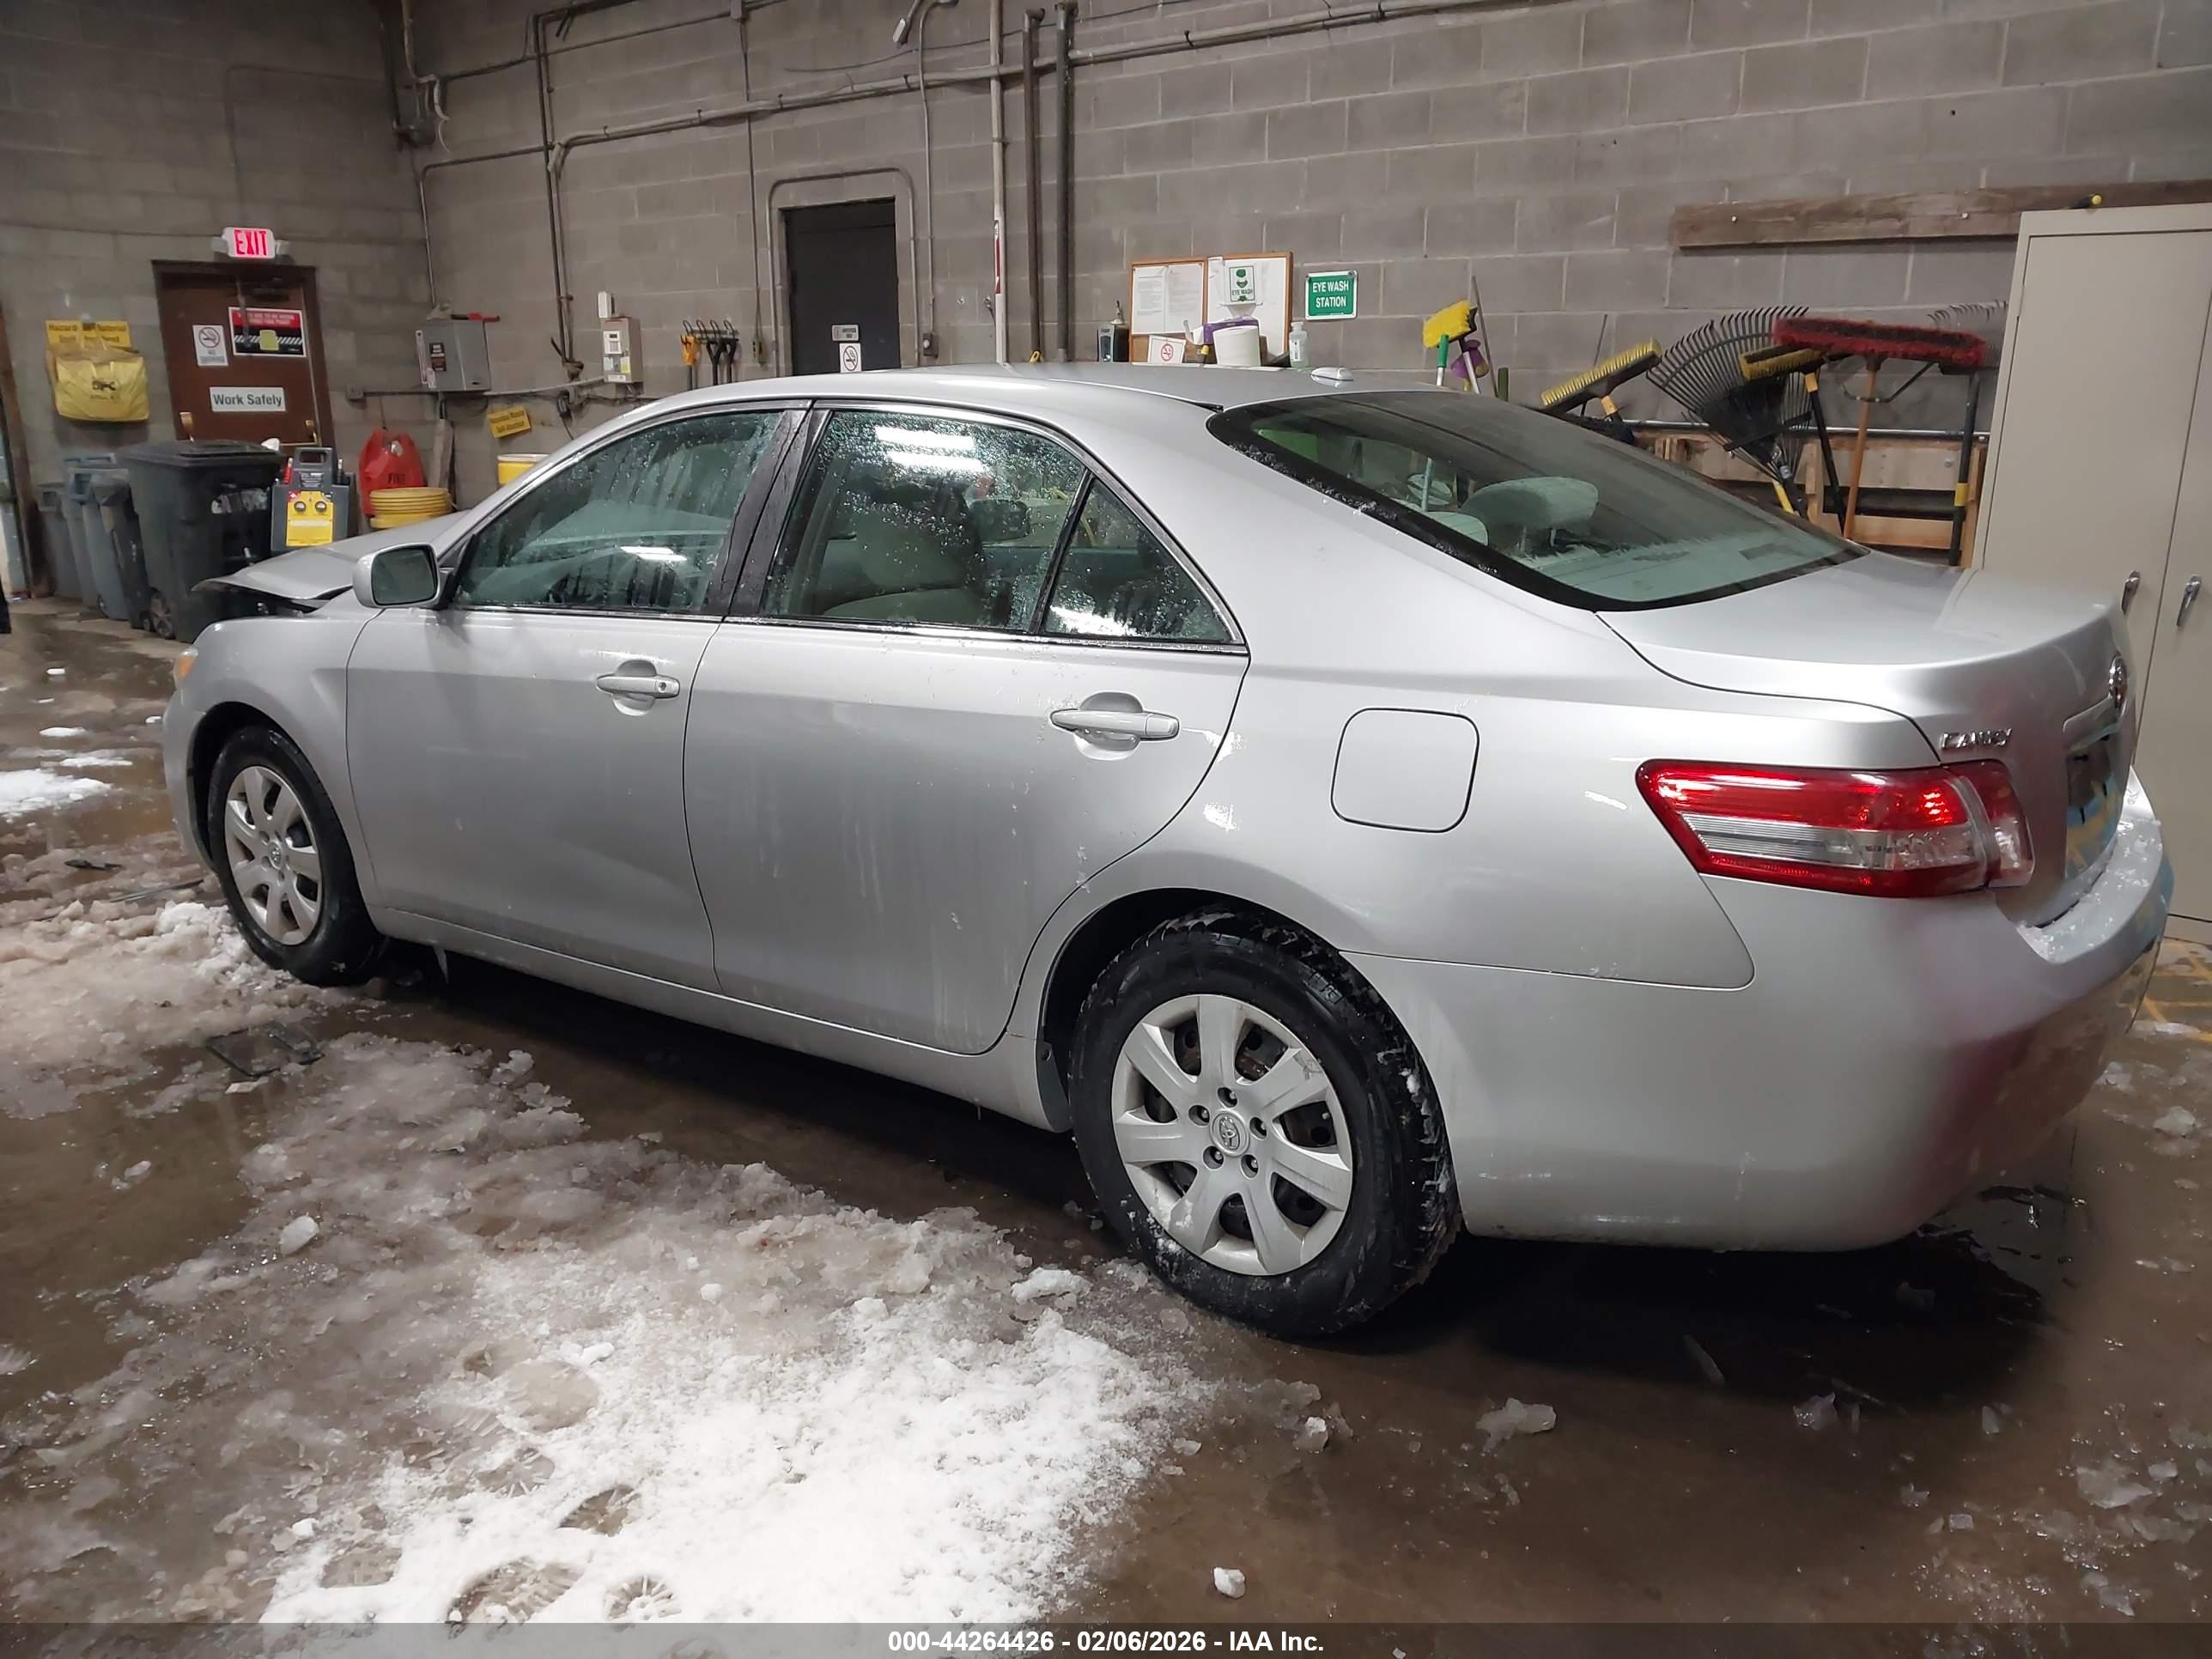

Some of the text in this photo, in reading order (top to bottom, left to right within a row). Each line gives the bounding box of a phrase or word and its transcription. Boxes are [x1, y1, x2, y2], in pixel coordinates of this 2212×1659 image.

[234, 229, 267, 256] EXIT
[1312, 280, 1349, 293] EYE WASH
[1316, 295, 1346, 308] STATION
[213, 393, 282, 407] Work Safely
